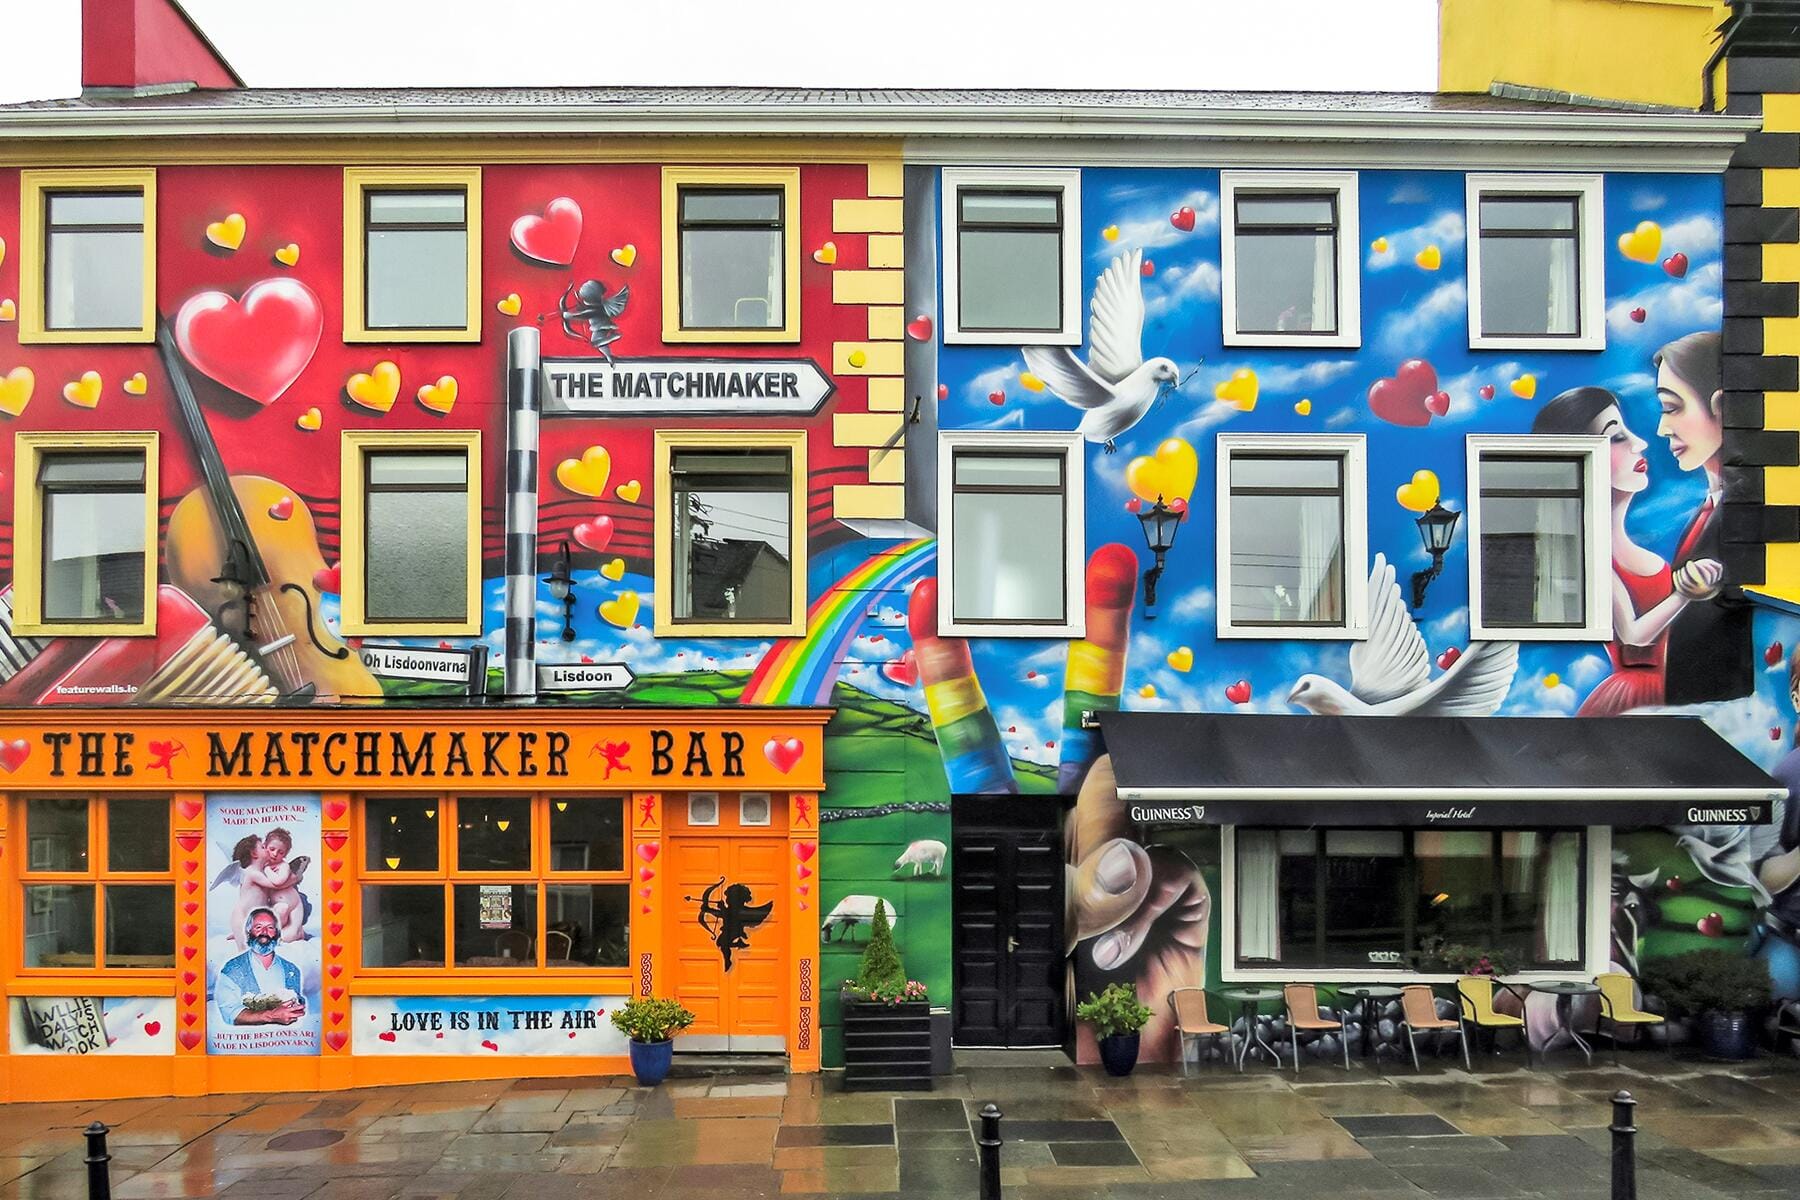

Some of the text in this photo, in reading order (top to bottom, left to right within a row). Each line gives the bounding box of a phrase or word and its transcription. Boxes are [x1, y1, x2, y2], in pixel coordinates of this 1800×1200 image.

[550, 372, 800, 398] THE MATCHMAKER
[363, 653, 467, 673] Oh Lisdoonvarna
[553, 670, 613, 682] Lisdoon
[56, 684, 138, 694] featurewalls.ie
[43, 730, 746, 777] THE MATCHMAKER BAR
[220, 804, 308, 815] SOME MATCHES ARE
[1131, 806, 1192, 821] GUINNESS
[1687, 807, 1748, 822] GUINNESS
[223, 817, 248, 825] MADE
[250, 816, 259, 825] IN
[391, 1010, 597, 1031] LOVE IS IN THE AIR
[254, 1031, 274, 1040] BEST
[276, 1030, 298, 1038] ONES
[300, 1030, 316, 1038] ARE
[67, 1034, 100, 1054] OOK
[213, 1042, 237, 1050] MADE
